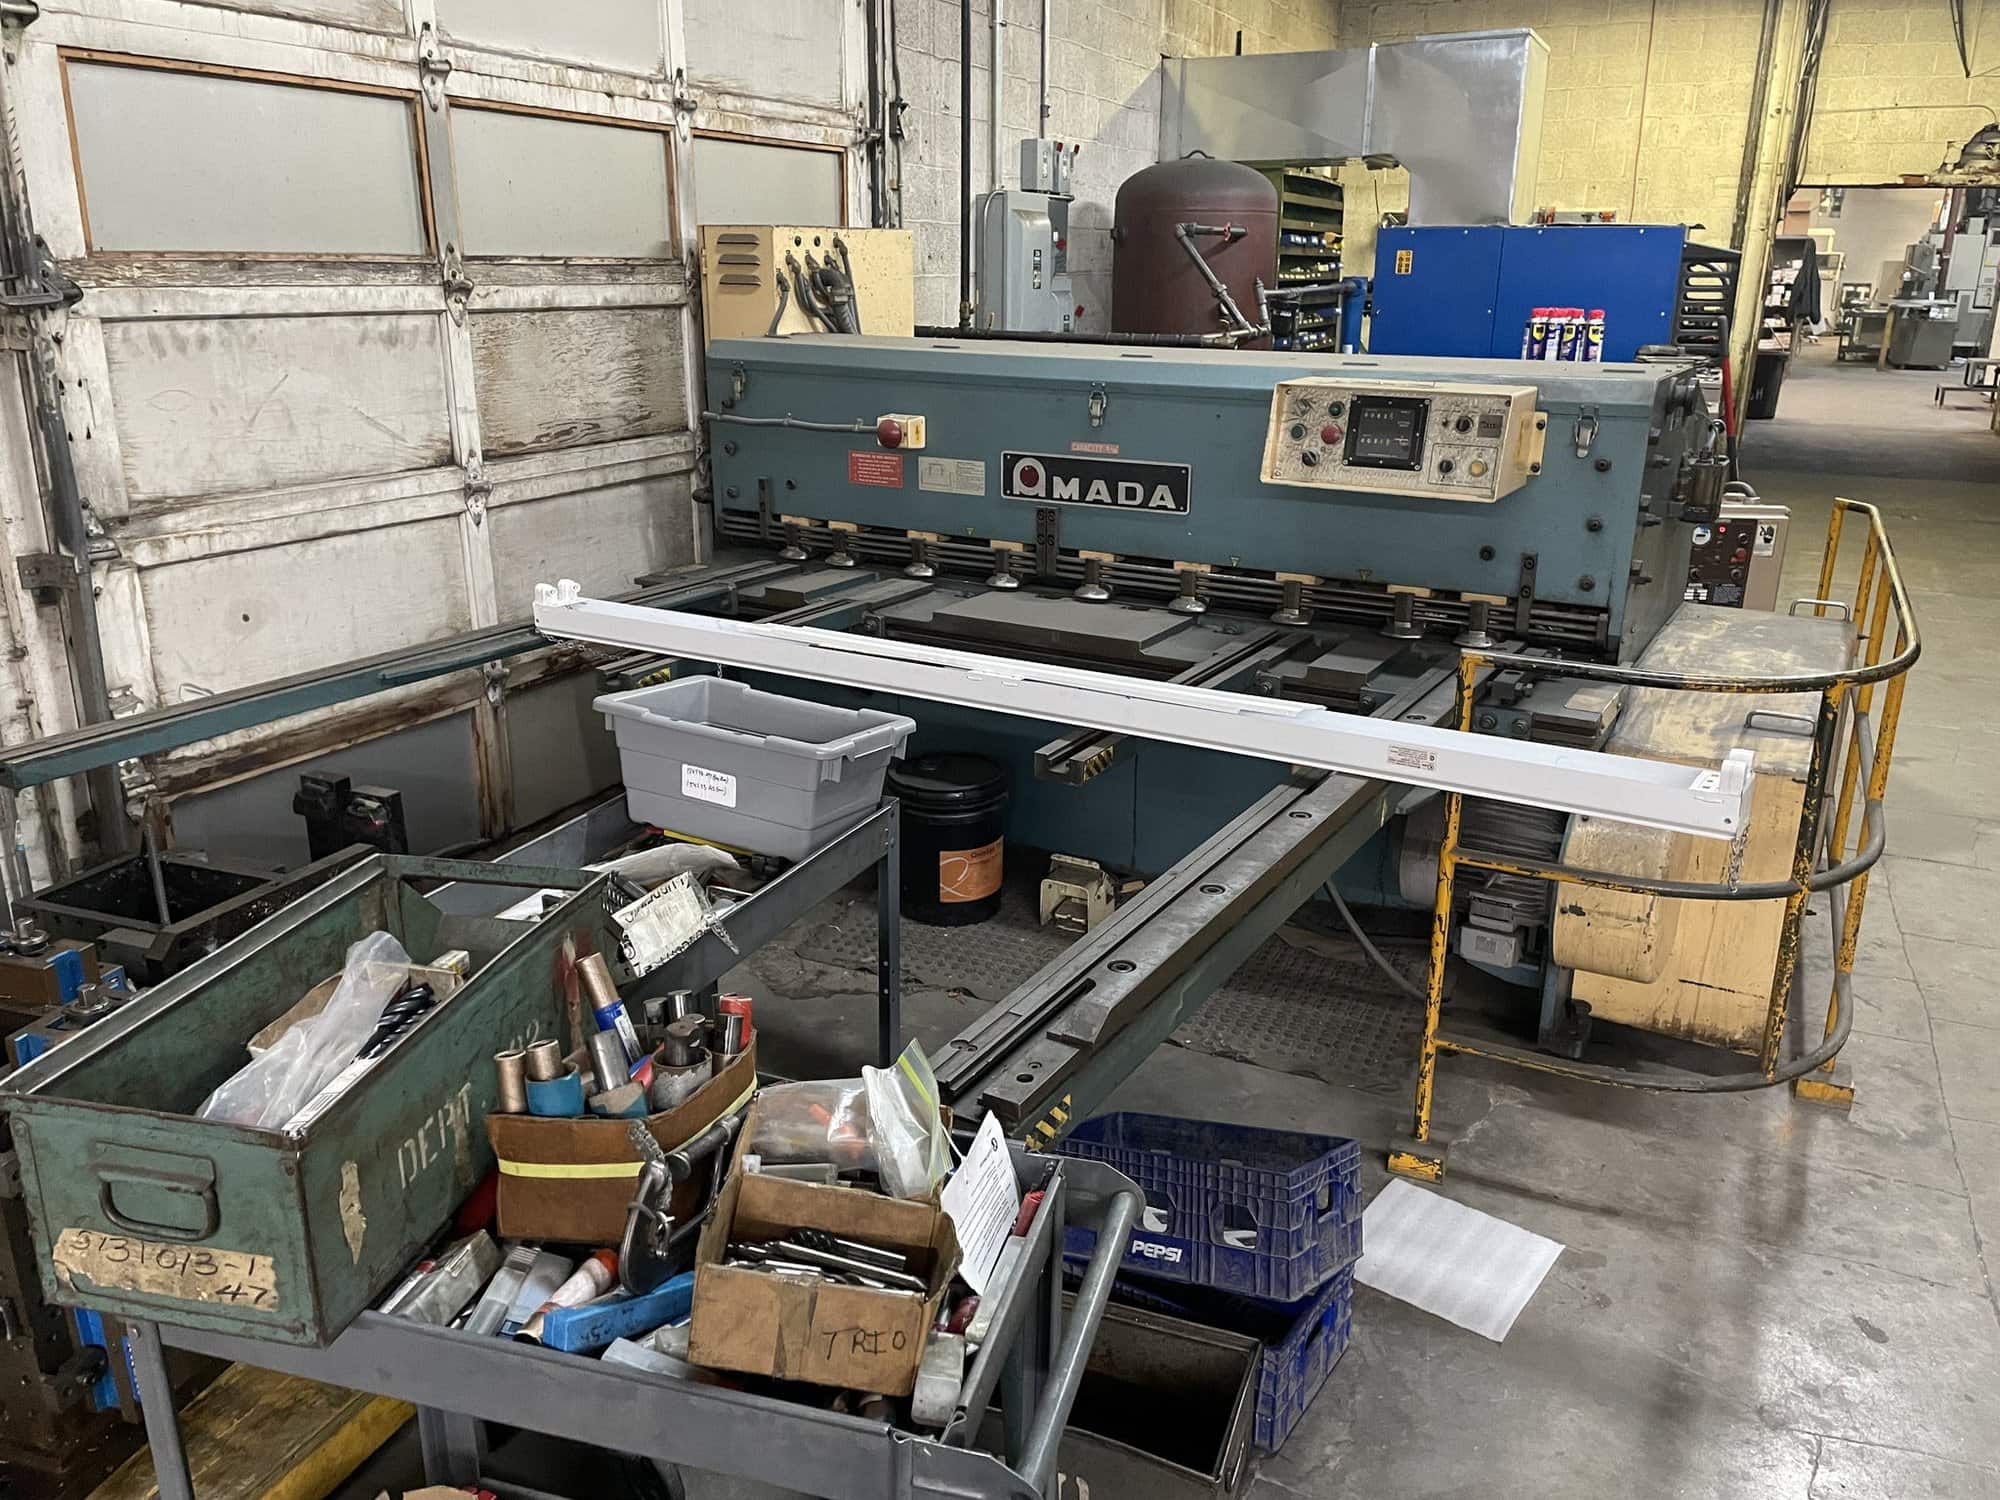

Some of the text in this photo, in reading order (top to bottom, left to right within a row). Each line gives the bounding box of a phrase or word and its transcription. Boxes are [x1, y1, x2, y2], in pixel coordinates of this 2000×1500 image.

[1012, 457, 1176, 509] AMADA
[1131, 1239, 1182, 1263] PEPSI
[823, 1326, 906, 1360] TRIO
